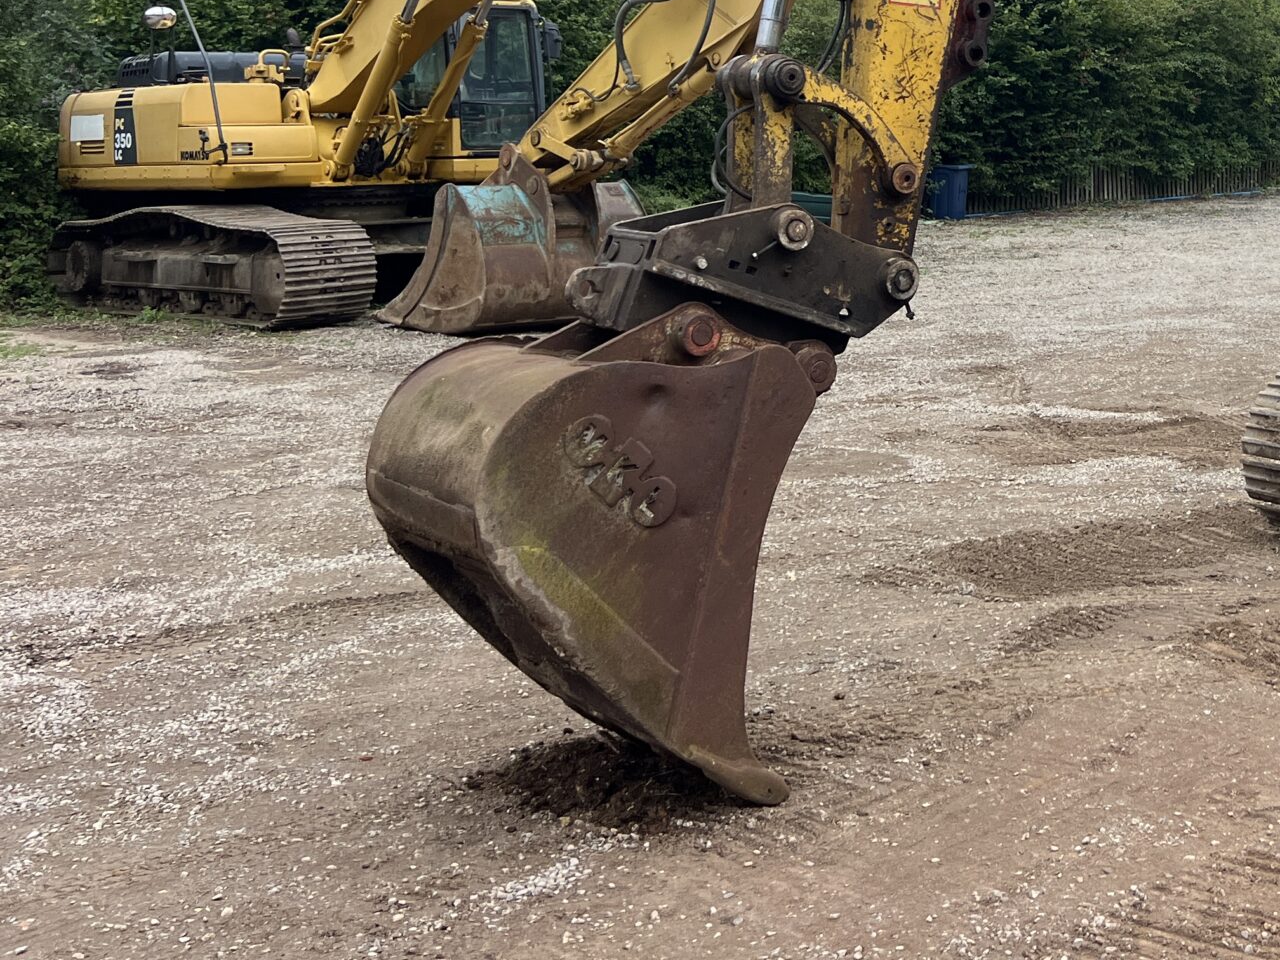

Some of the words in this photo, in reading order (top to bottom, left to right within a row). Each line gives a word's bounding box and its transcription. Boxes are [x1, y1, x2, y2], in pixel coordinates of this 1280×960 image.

[115, 118, 124, 130] PC
[115, 133, 132, 148] 350
[115, 150, 123, 160] LC
